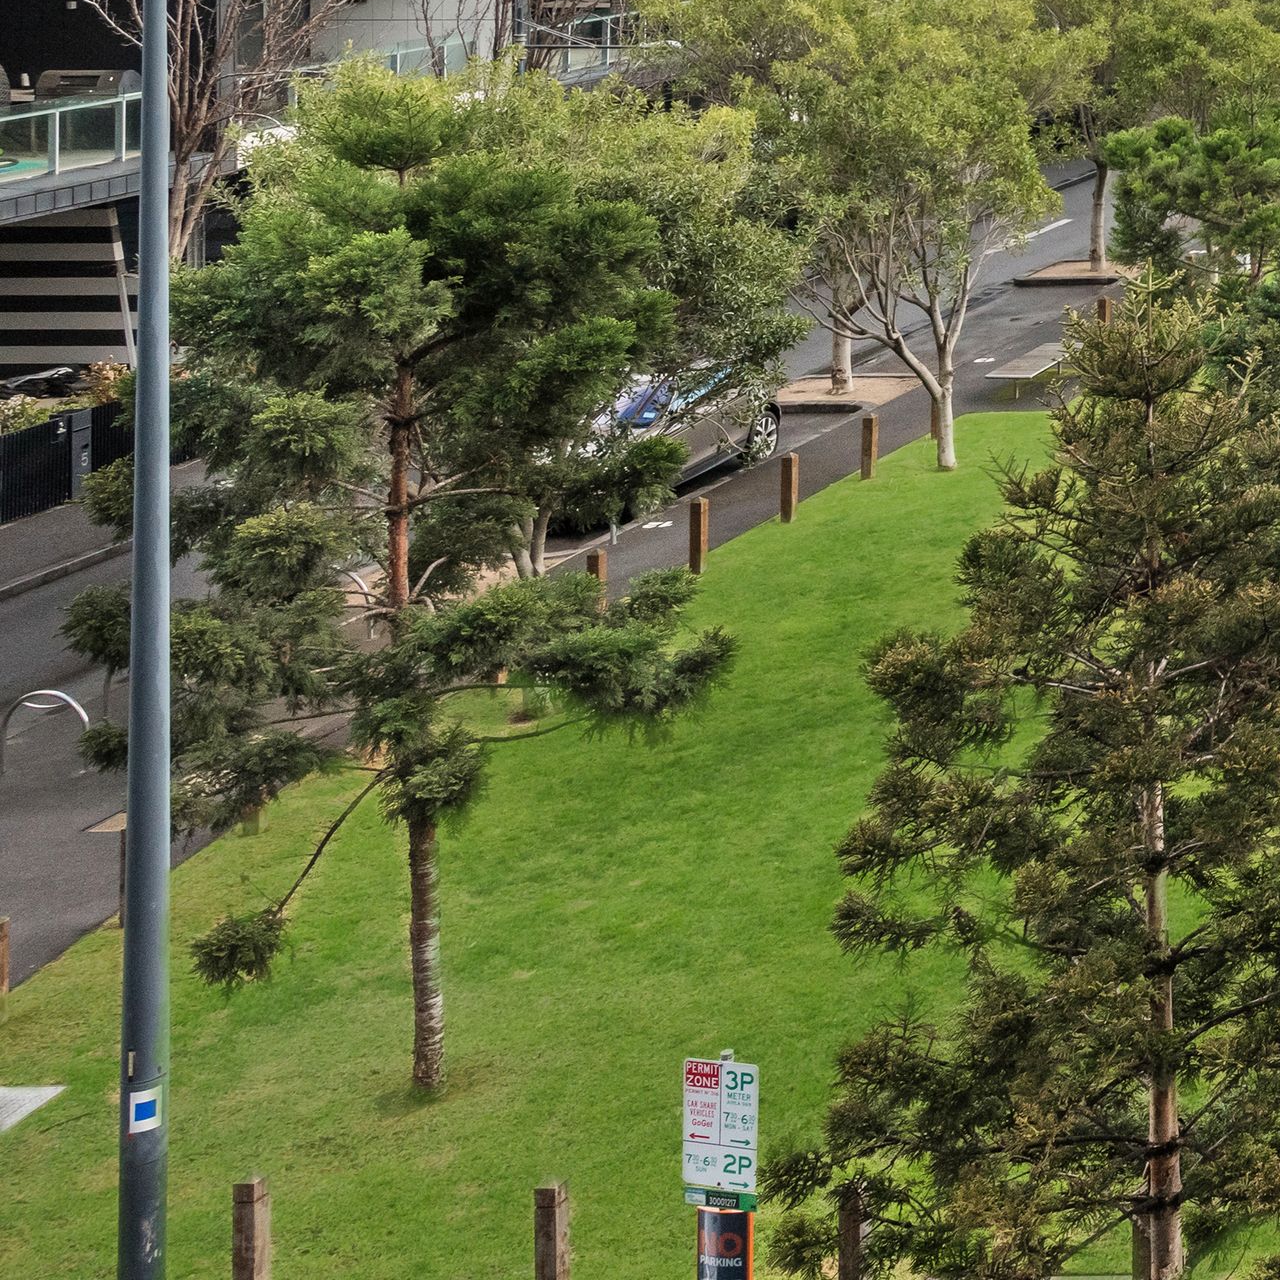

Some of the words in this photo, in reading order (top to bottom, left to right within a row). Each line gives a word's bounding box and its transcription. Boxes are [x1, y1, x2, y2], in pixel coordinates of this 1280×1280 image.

[81, 452, 88, 466] 5
[686, 1062, 719, 1075] PERMIT
[686, 1075, 719, 1088] ZONE
[725, 1071, 754, 1091] 3P
[727, 1092, 751, 1101] METER
[687, 1100, 697, 1108] CAR
[690, 1108, 714, 1118] VEHICLES
[723, 1154, 752, 1175] 2P
[709, 1196, 737, 1207] 30001217
[699, 1229, 743, 1258] NO
[700, 1254, 743, 1267] PARKING
